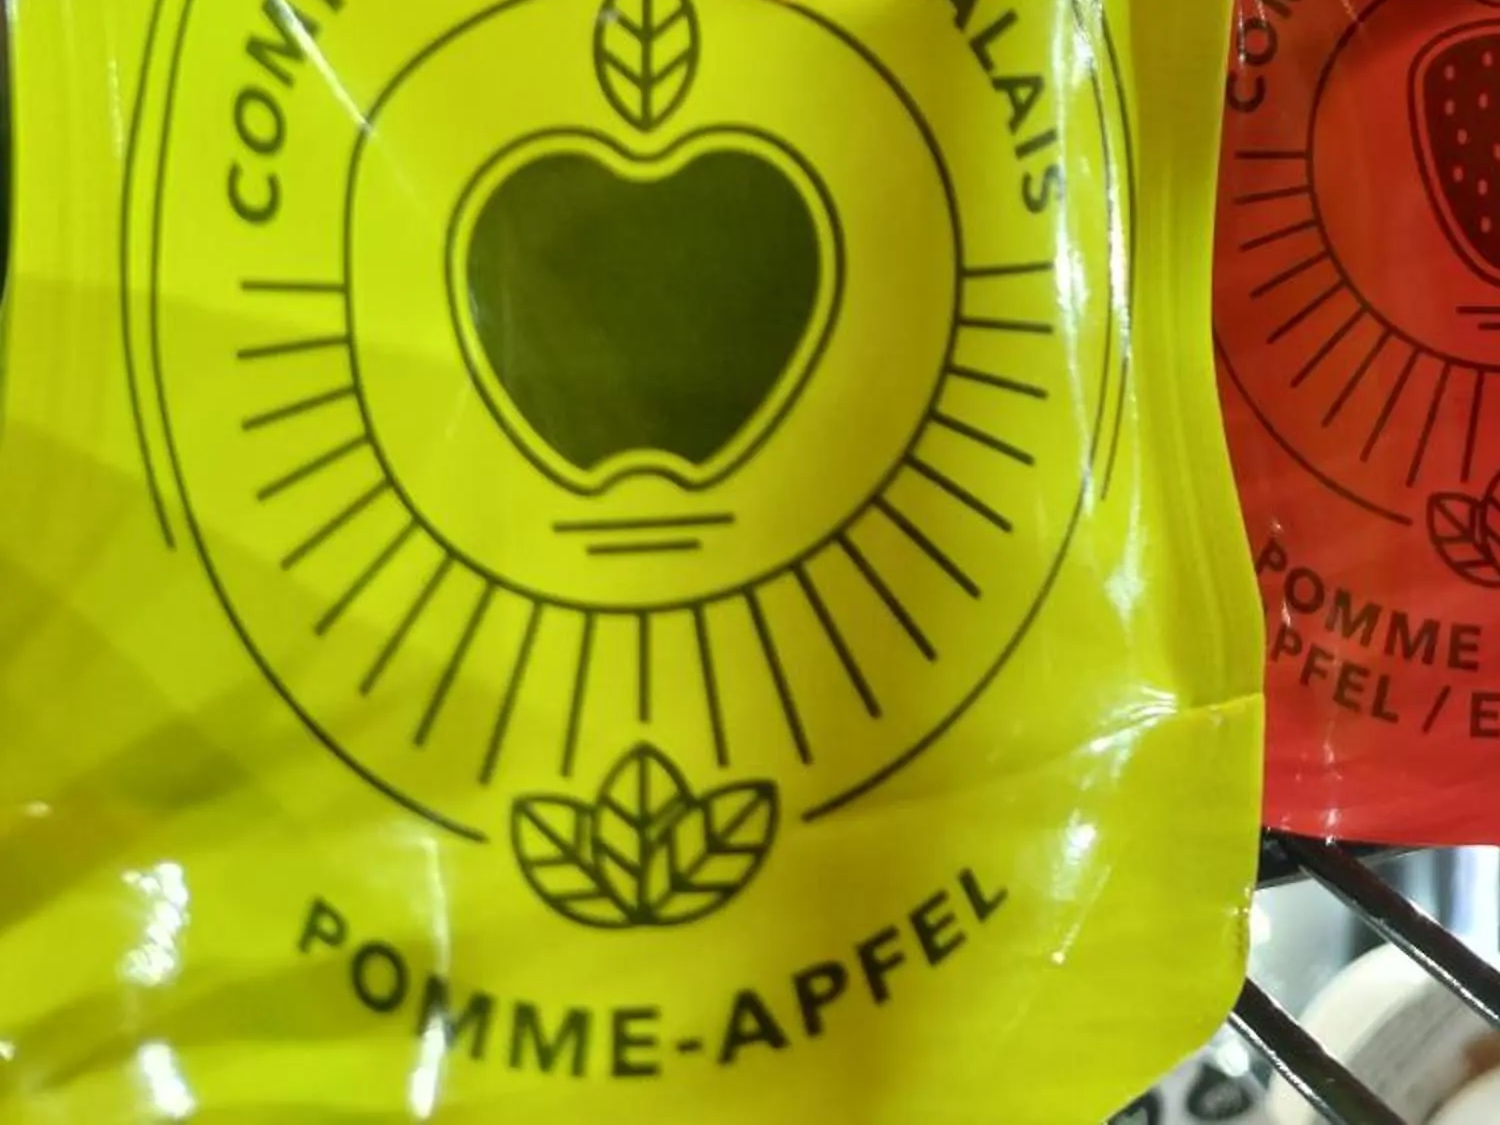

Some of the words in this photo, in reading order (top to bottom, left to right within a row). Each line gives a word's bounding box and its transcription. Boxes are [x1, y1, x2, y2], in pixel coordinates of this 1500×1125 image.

[1254, 537, 1482, 673] POMME
[1268, 623, 1400, 724] PFEL
[296, 866, 1009, 1079] POMME-APFEL
